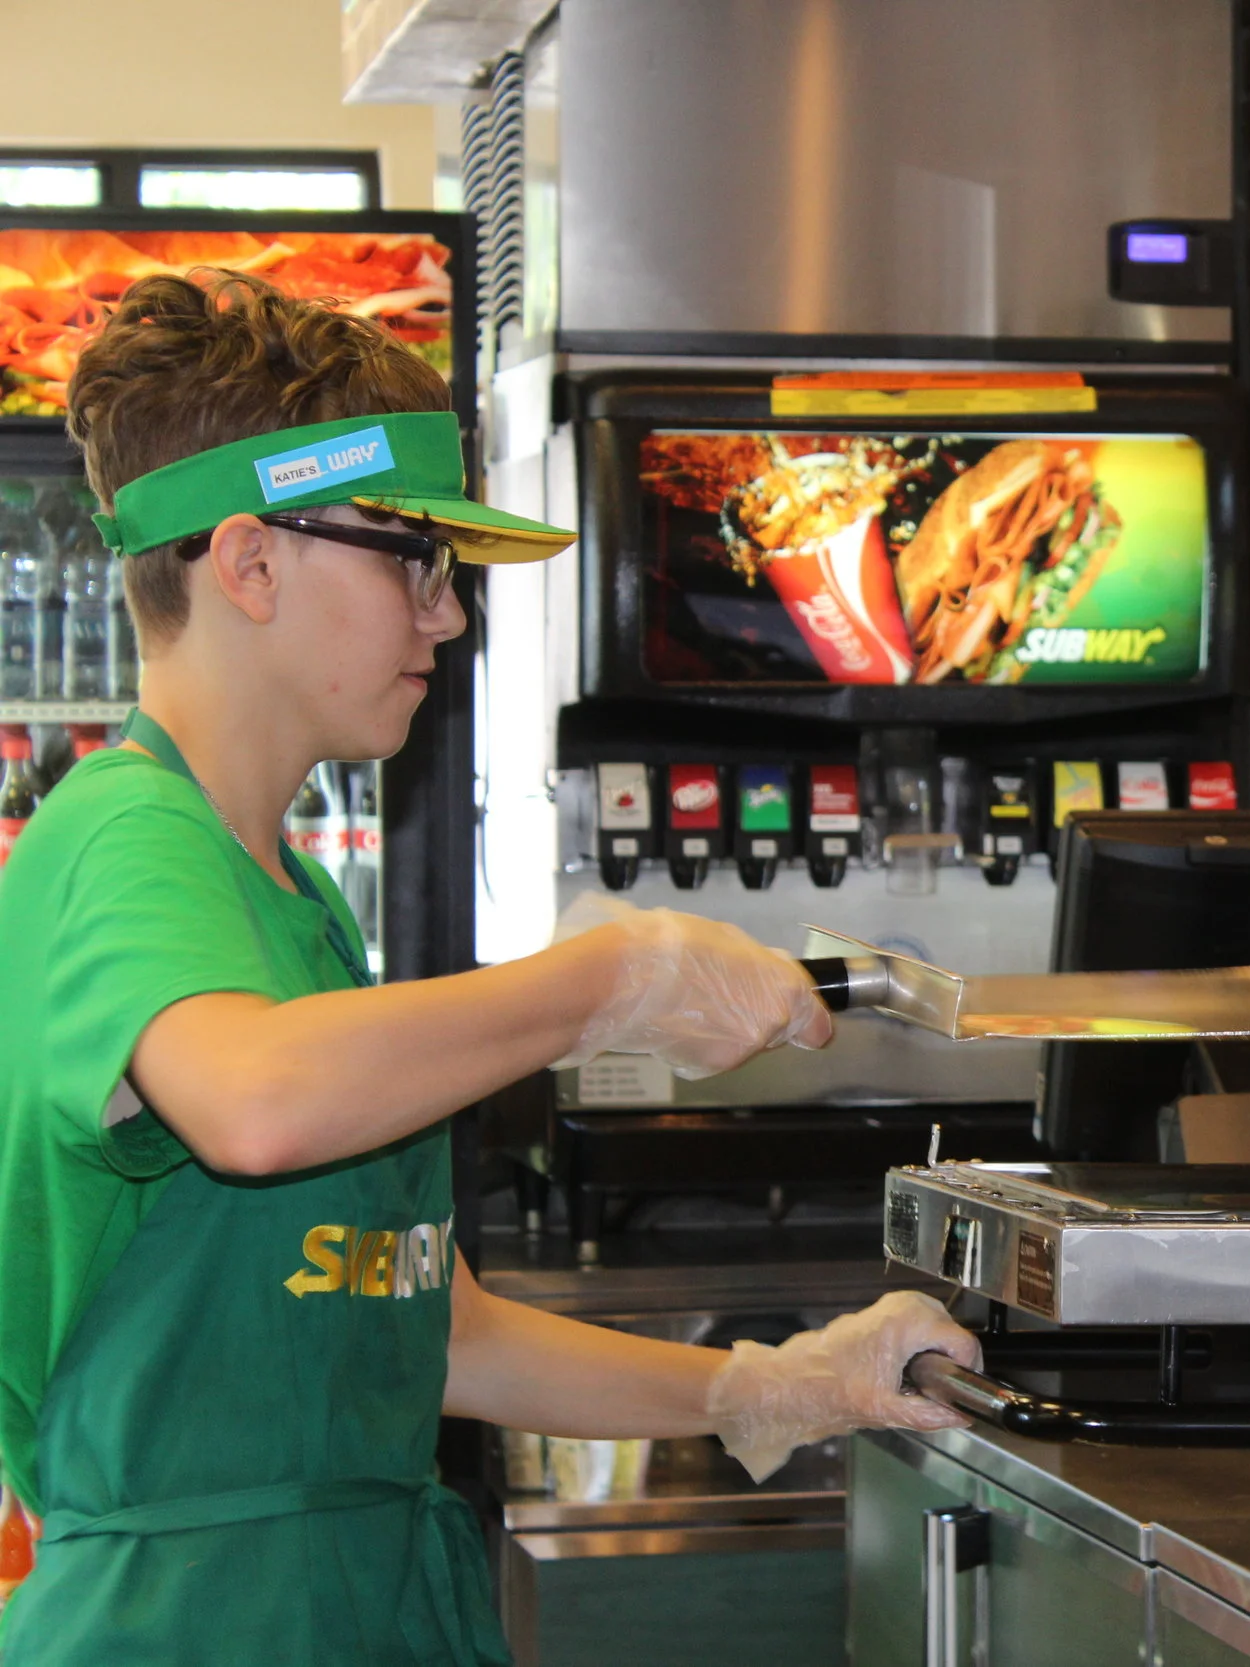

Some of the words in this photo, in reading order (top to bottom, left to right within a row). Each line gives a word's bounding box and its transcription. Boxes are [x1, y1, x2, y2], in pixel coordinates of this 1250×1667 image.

[274, 465, 317, 484] KATIE'S
[326, 441, 379, 471] WAY
[1015, 627, 1167, 663] SUBWAY
